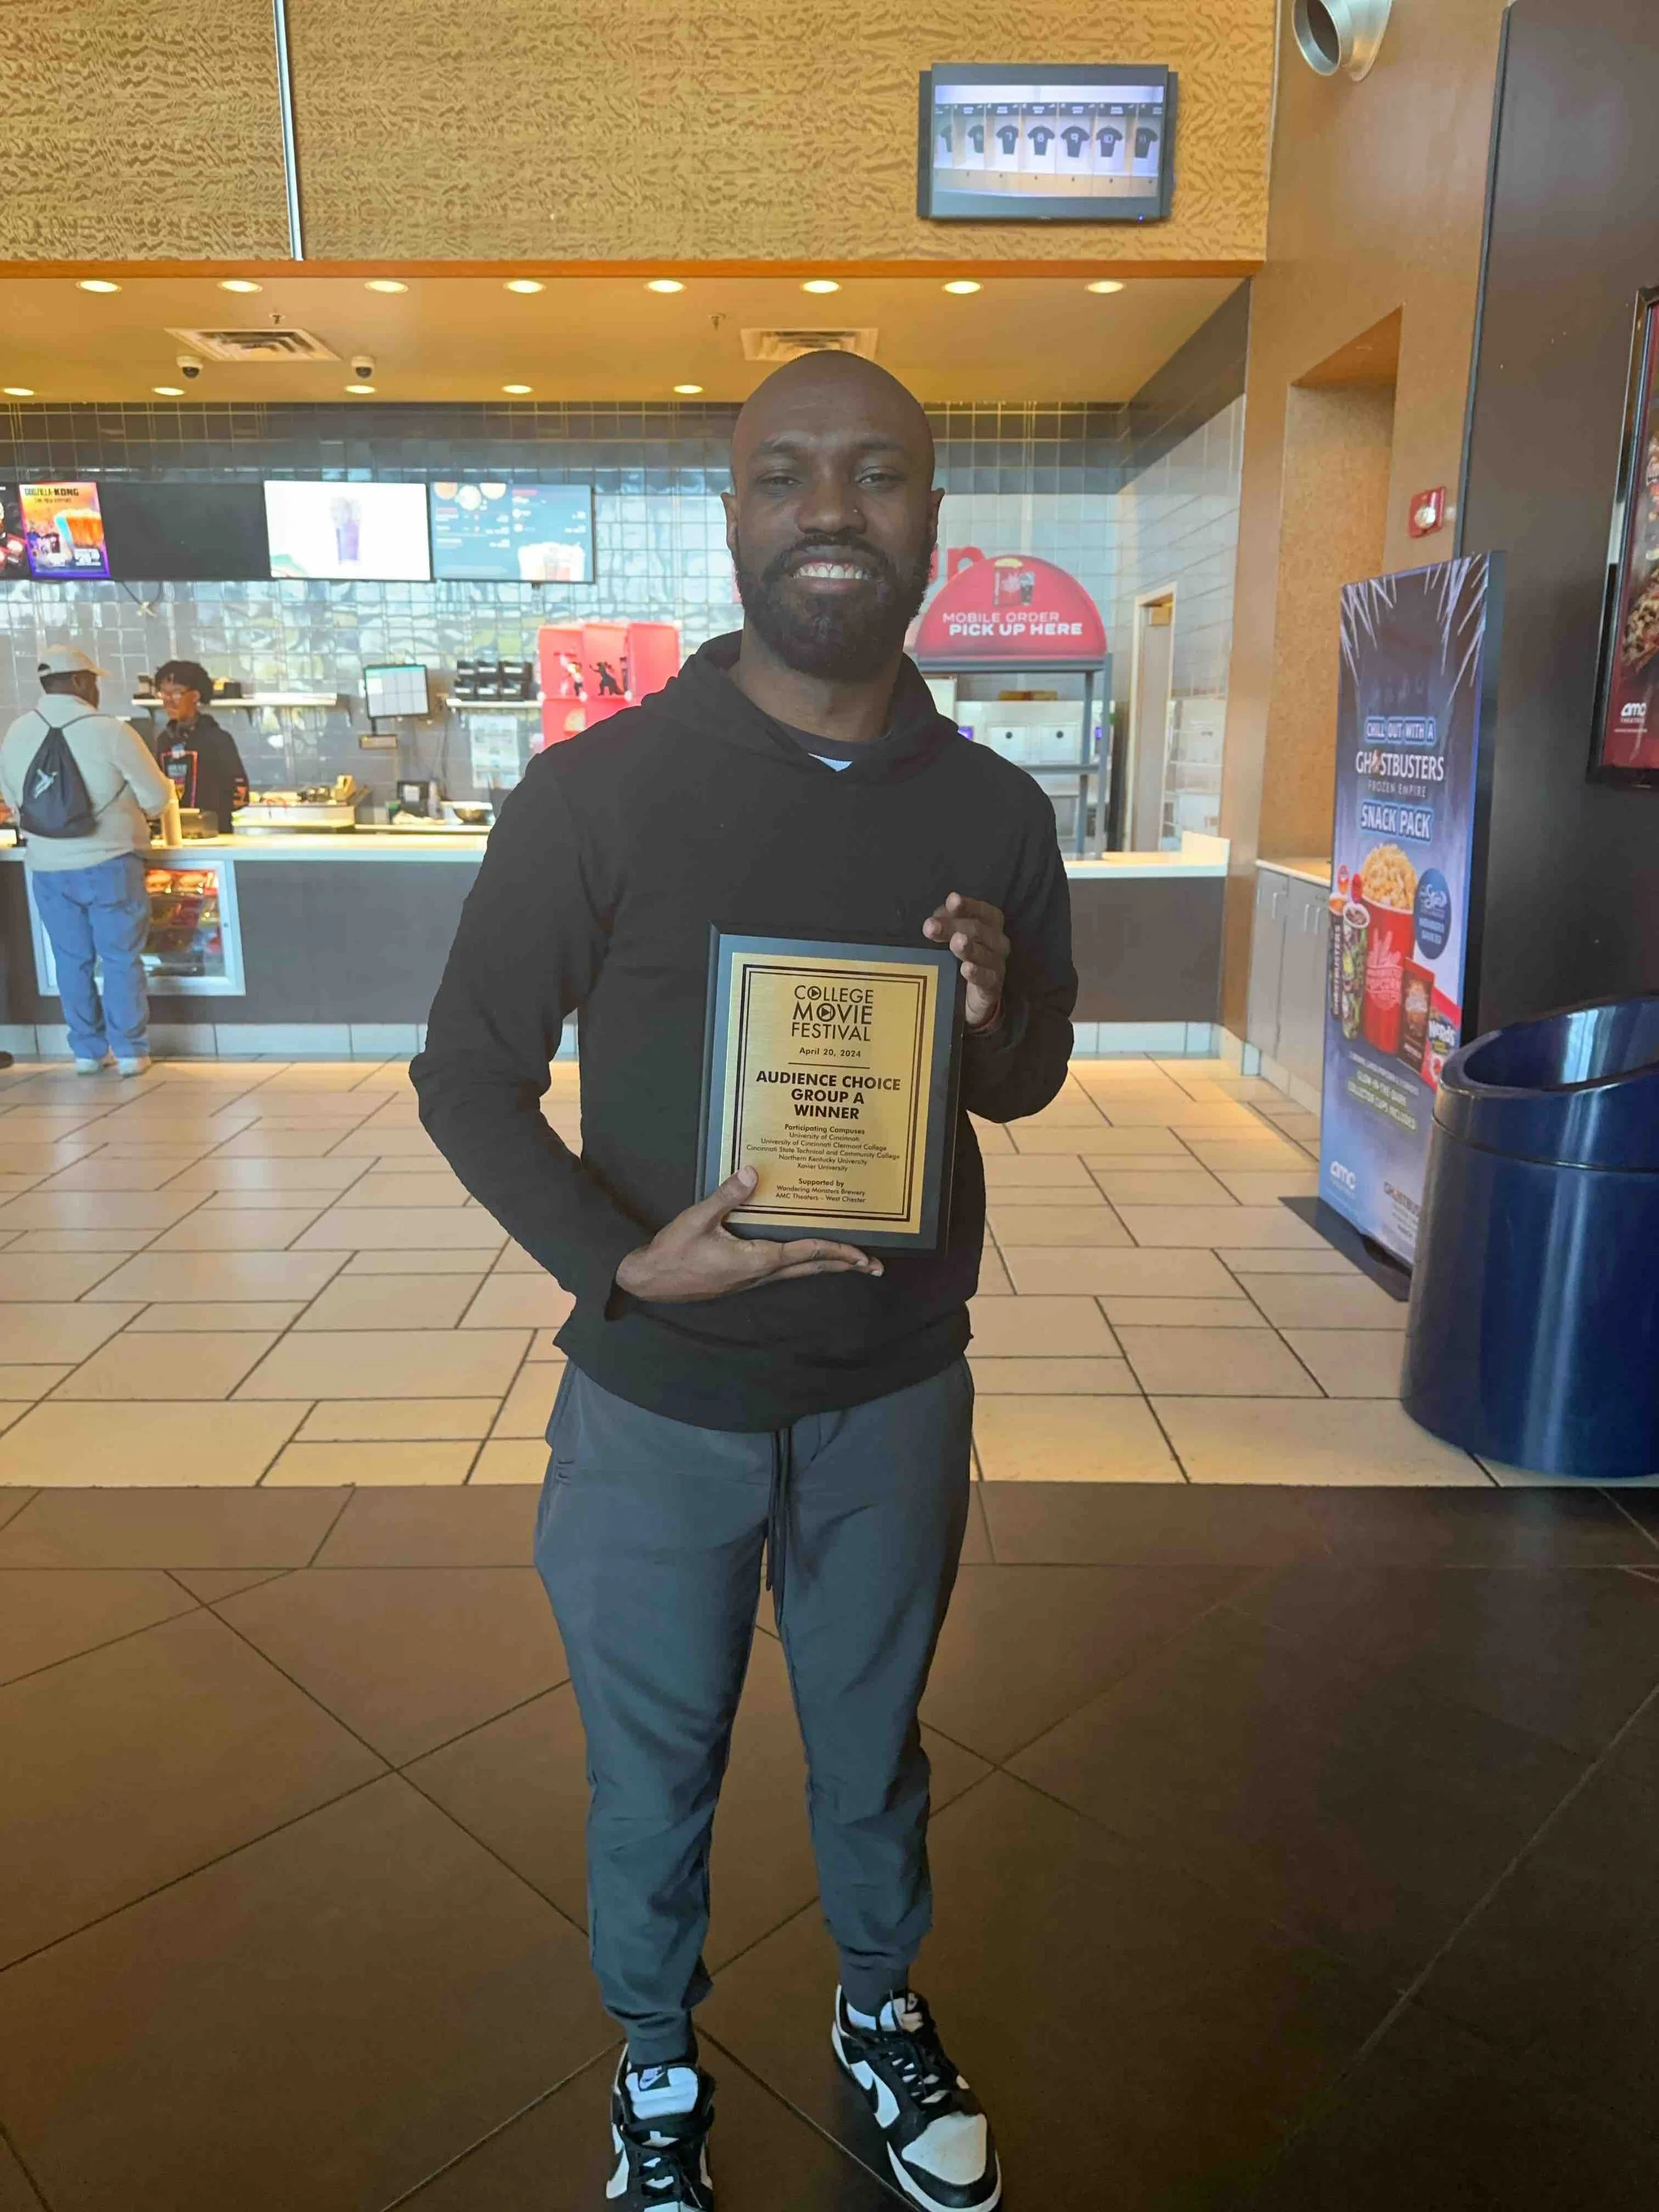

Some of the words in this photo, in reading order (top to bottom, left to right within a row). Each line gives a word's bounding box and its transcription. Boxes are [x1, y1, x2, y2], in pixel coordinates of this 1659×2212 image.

[54, 488, 79, 496] KONG
[942, 612, 1001, 623] MOBILE
[1005, 611, 1060, 623] ORDER
[949, 624, 994, 636] PICK
[999, 624, 1026, 636] UP
[1030, 623, 1083, 635] HERE
[1366, 722, 1385, 738] CHILL
[1388, 722, 1403, 738] OUT
[1406, 722, 1424, 739] WITH
[1427, 723, 1434, 739] A
[1368, 780, 1396, 794] FROZEN
[1362, 805, 1396, 832] SNACK
[1399, 810, 1431, 839] PACK
[794, 985, 874, 1004] COLLEGE
[793, 1000, 873, 1025] MOVIE
[791, 1022, 871, 1041] FESTIVAL
[756, 1070, 837, 1086] AUDIENCE
[842, 1075, 901, 1090] CHOICE
[791, 1088, 848, 1103] GROUP
[853, 1092, 864, 1104] A
[794, 1104, 859, 1120] WINNER
[785, 1124, 827, 1133] Participating
[830, 1126, 865, 1135] Campuses
[839, 1150, 875, 1159] Community
[818, 1163, 848, 1172] University
[776, 1185, 810, 1193] Wandering
